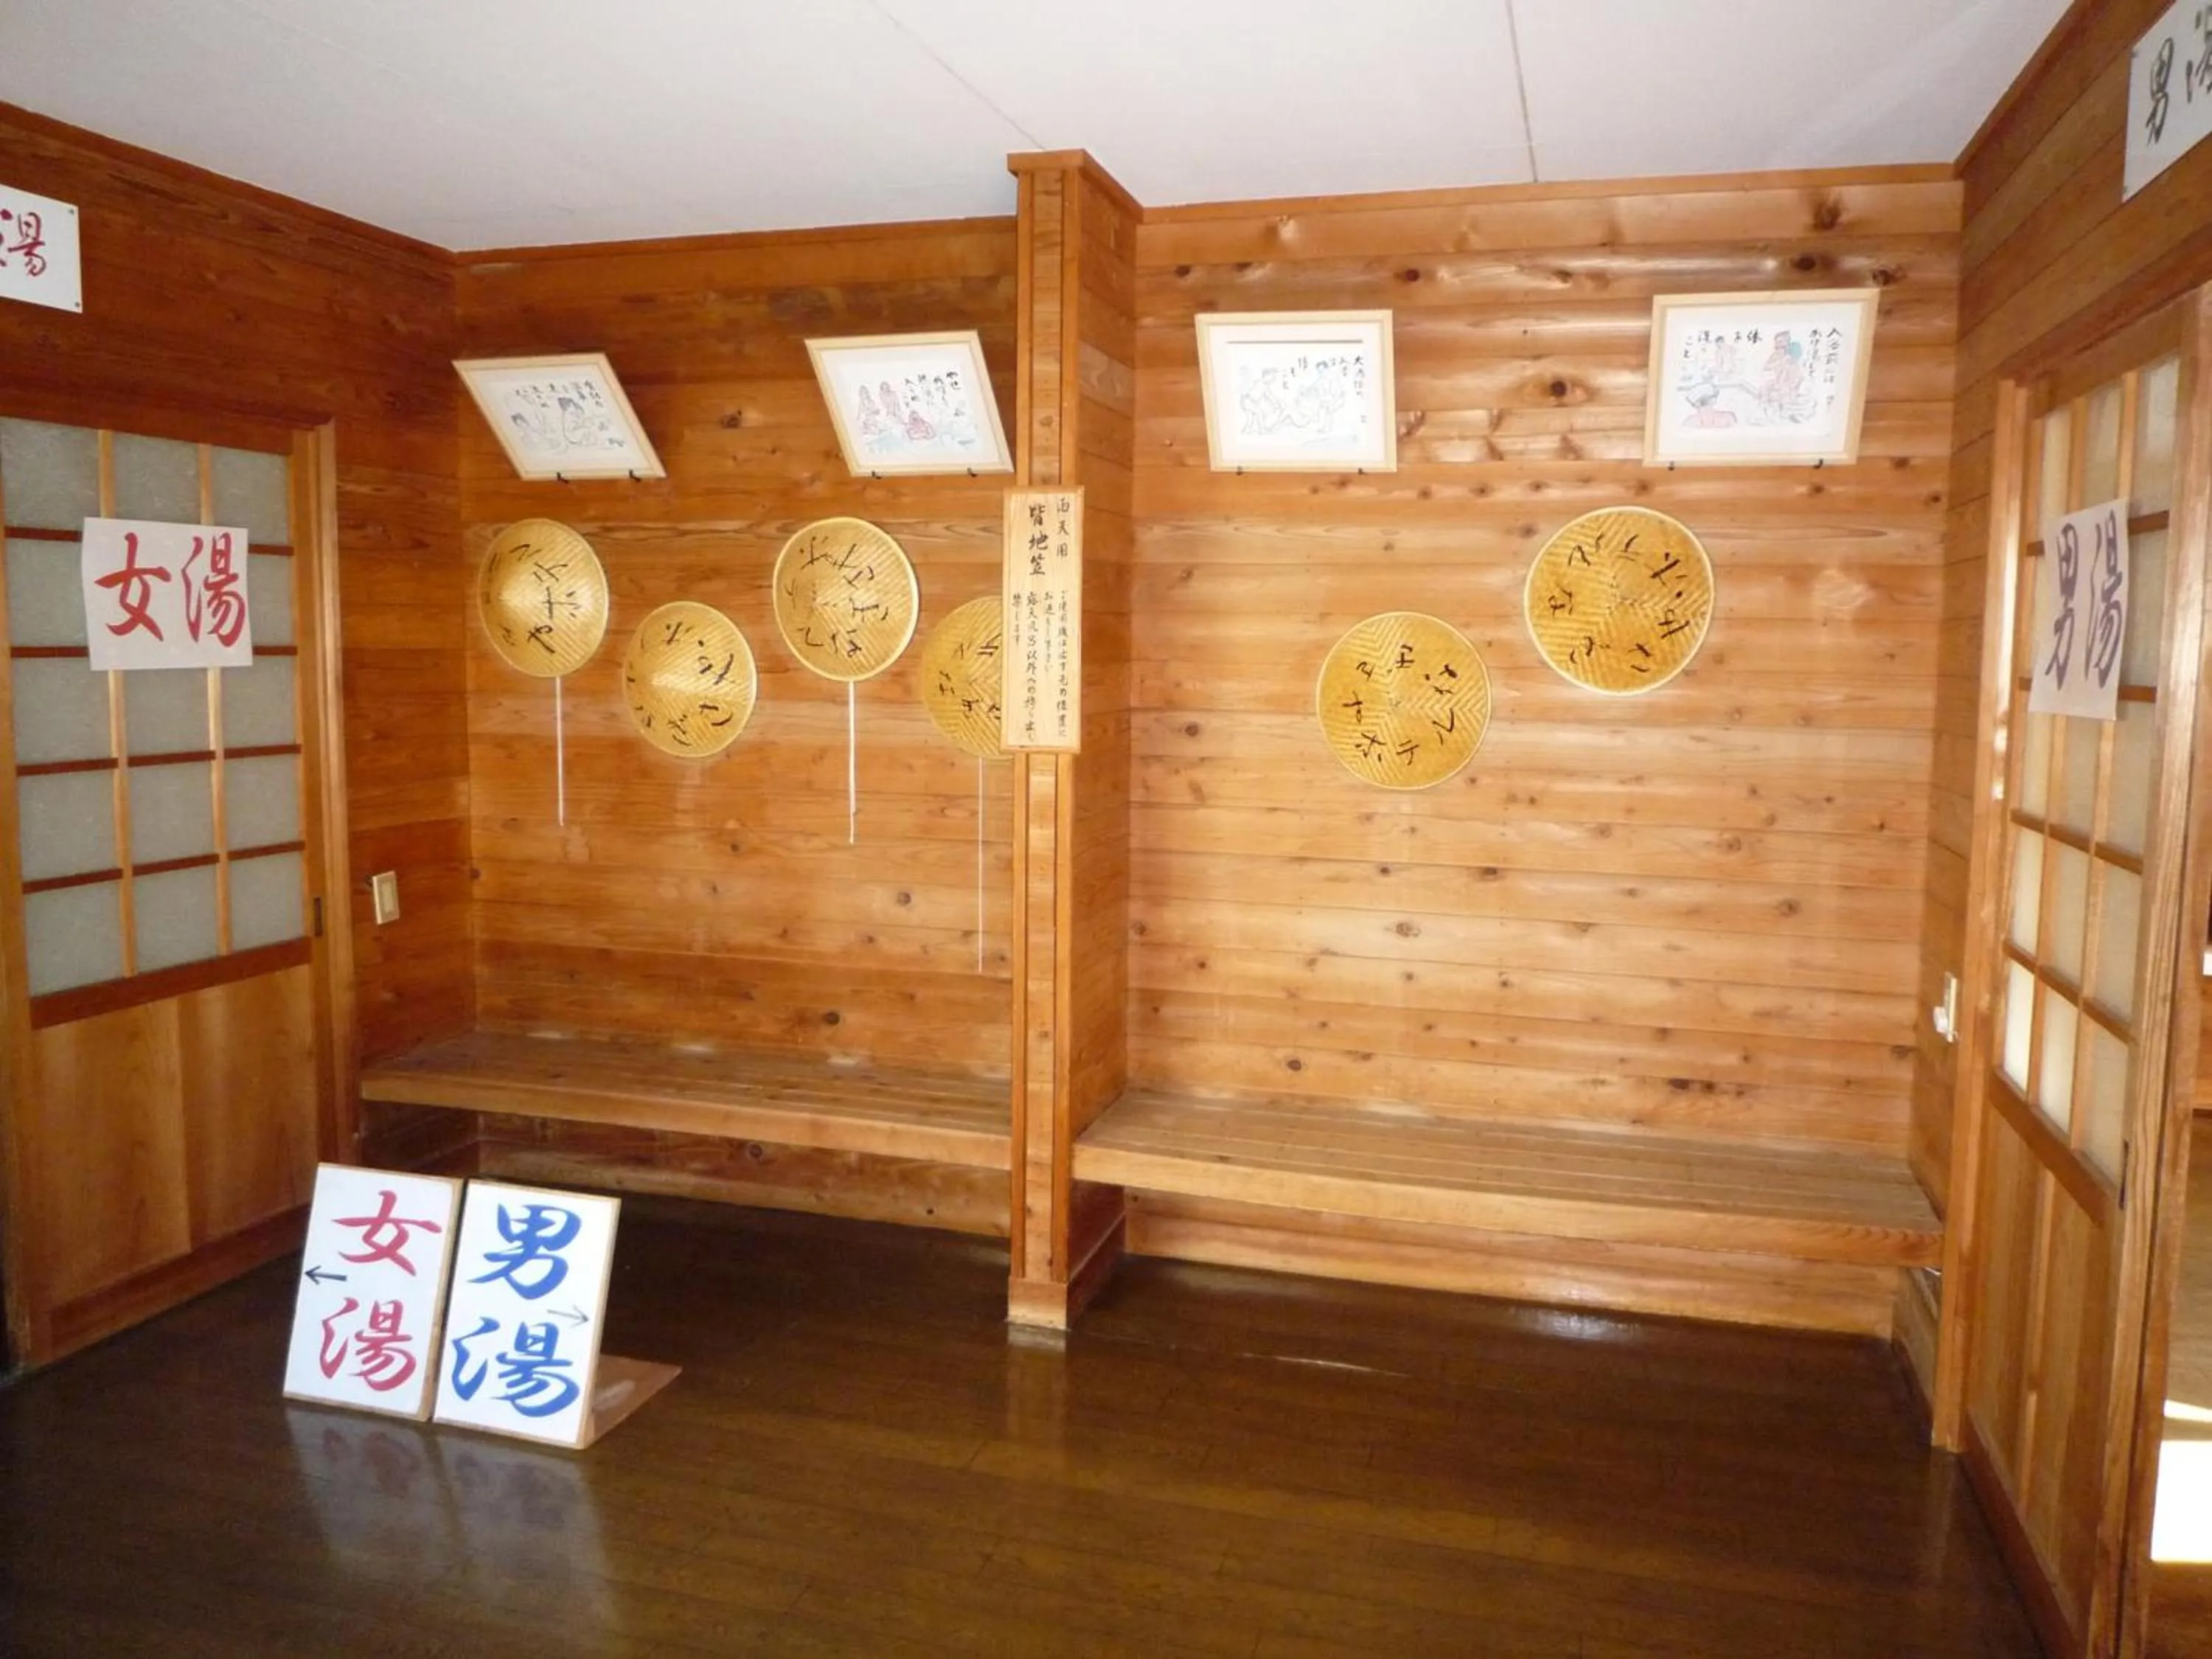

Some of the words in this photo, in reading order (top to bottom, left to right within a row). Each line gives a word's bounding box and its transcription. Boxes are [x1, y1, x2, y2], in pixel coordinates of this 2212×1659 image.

[94, 532, 246, 647] 女湯
[1029, 504, 1048, 575] 皆地笠
[2045, 509, 2123, 691] 男湯
[320, 1190, 442, 1391] 女湯
[452, 1203, 582, 1417] 男湯
